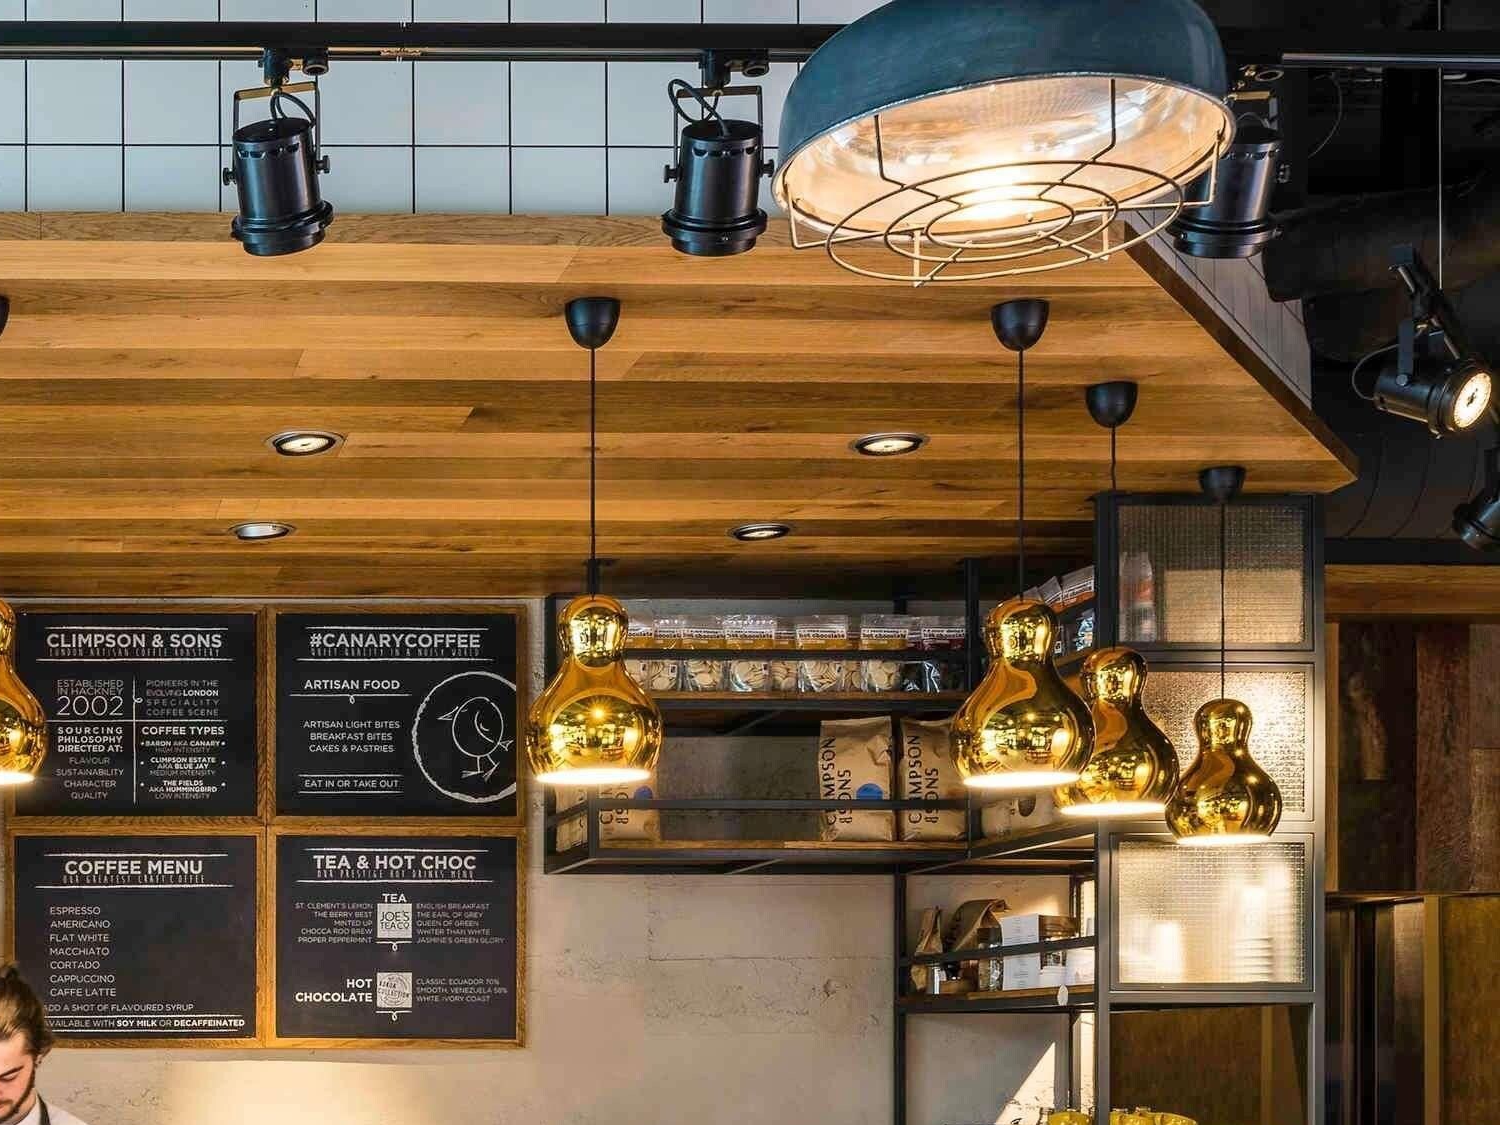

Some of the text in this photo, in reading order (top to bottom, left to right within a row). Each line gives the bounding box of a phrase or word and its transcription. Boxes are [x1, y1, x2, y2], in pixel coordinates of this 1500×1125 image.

[47, 634, 222, 648] CLIMPSON & SONS
[310, 634, 481, 648] #CANARYCOFFEE
[57, 679, 123, 688] ESTABLISHED
[304, 680, 400, 689] ARTISAN FOOD
[58, 688, 123, 696] IN HACKNEY
[57, 696, 123, 715] 2002
[303, 721, 400, 729] ARTISAN LIGHT BITES
[58, 727, 123, 735] SOURCING
[142, 727, 225, 735] COFFEE TYPES
[310, 733, 392, 741] BREAKFAST BITES
[69, 757, 110, 765] FLAVOUR
[64, 780, 116, 788] CHARACTER
[305, 780, 399, 788] EAT IN OR TAKE OUT
[822, 736, 836, 825] CLMPSON
[71, 792, 108, 800] QUALITY
[65, 860, 202, 874] COFFEE MENU
[313, 856, 476, 870] TEA & HOT CHOC
[383, 894, 407, 902] TEA
[50, 907, 100, 915] ESPRESSO
[380, 911, 410, 922] JOE'S
[50, 920, 111, 928] AMERICANO
[50, 934, 109, 942] FLAT WHITE
[50, 948, 109, 956] MACCHIATO
[50, 961, 100, 969] CORTADO
[50, 975, 115, 983] CAPPUCCINO
[347, 979, 372, 988] HOT
[50, 988, 116, 997] CAFFE LATTE
[295, 992, 372, 1002] CHOCOLATE
[63, 1004, 193, 1012] A SHOT OF FLAVOURED SYRUP
